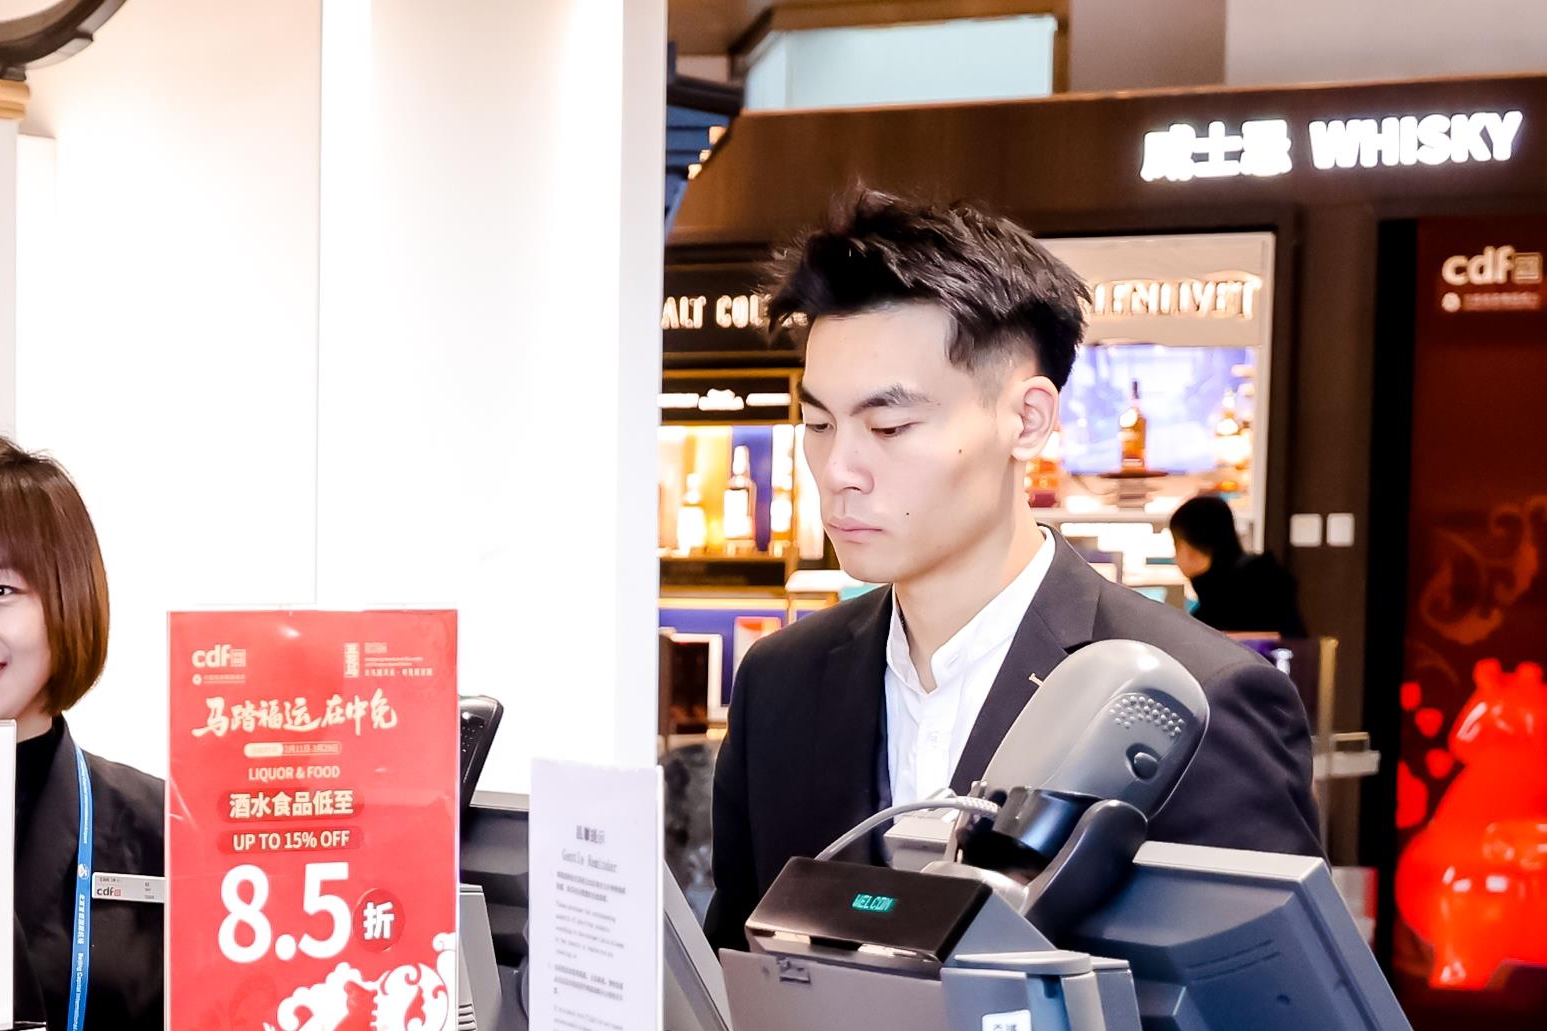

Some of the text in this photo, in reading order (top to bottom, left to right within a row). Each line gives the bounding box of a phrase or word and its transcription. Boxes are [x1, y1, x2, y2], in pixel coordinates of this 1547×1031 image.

[1309, 110, 1524, 170] WHISKY
[1441, 244, 1515, 285] cdf
[661, 296, 706, 329] ALT
[1090, 280, 1262, 320] LENLIVET
[192, 643, 231, 668] cdf
[248, 764, 341, 782] LIQUOR & FOOD
[229, 789, 354, 819] 酒水食品低至
[233, 829, 351, 852] UP TO 15% OFF
[96, 886, 115, 896] cdf
[217, 861, 395, 964] 8.5 折
